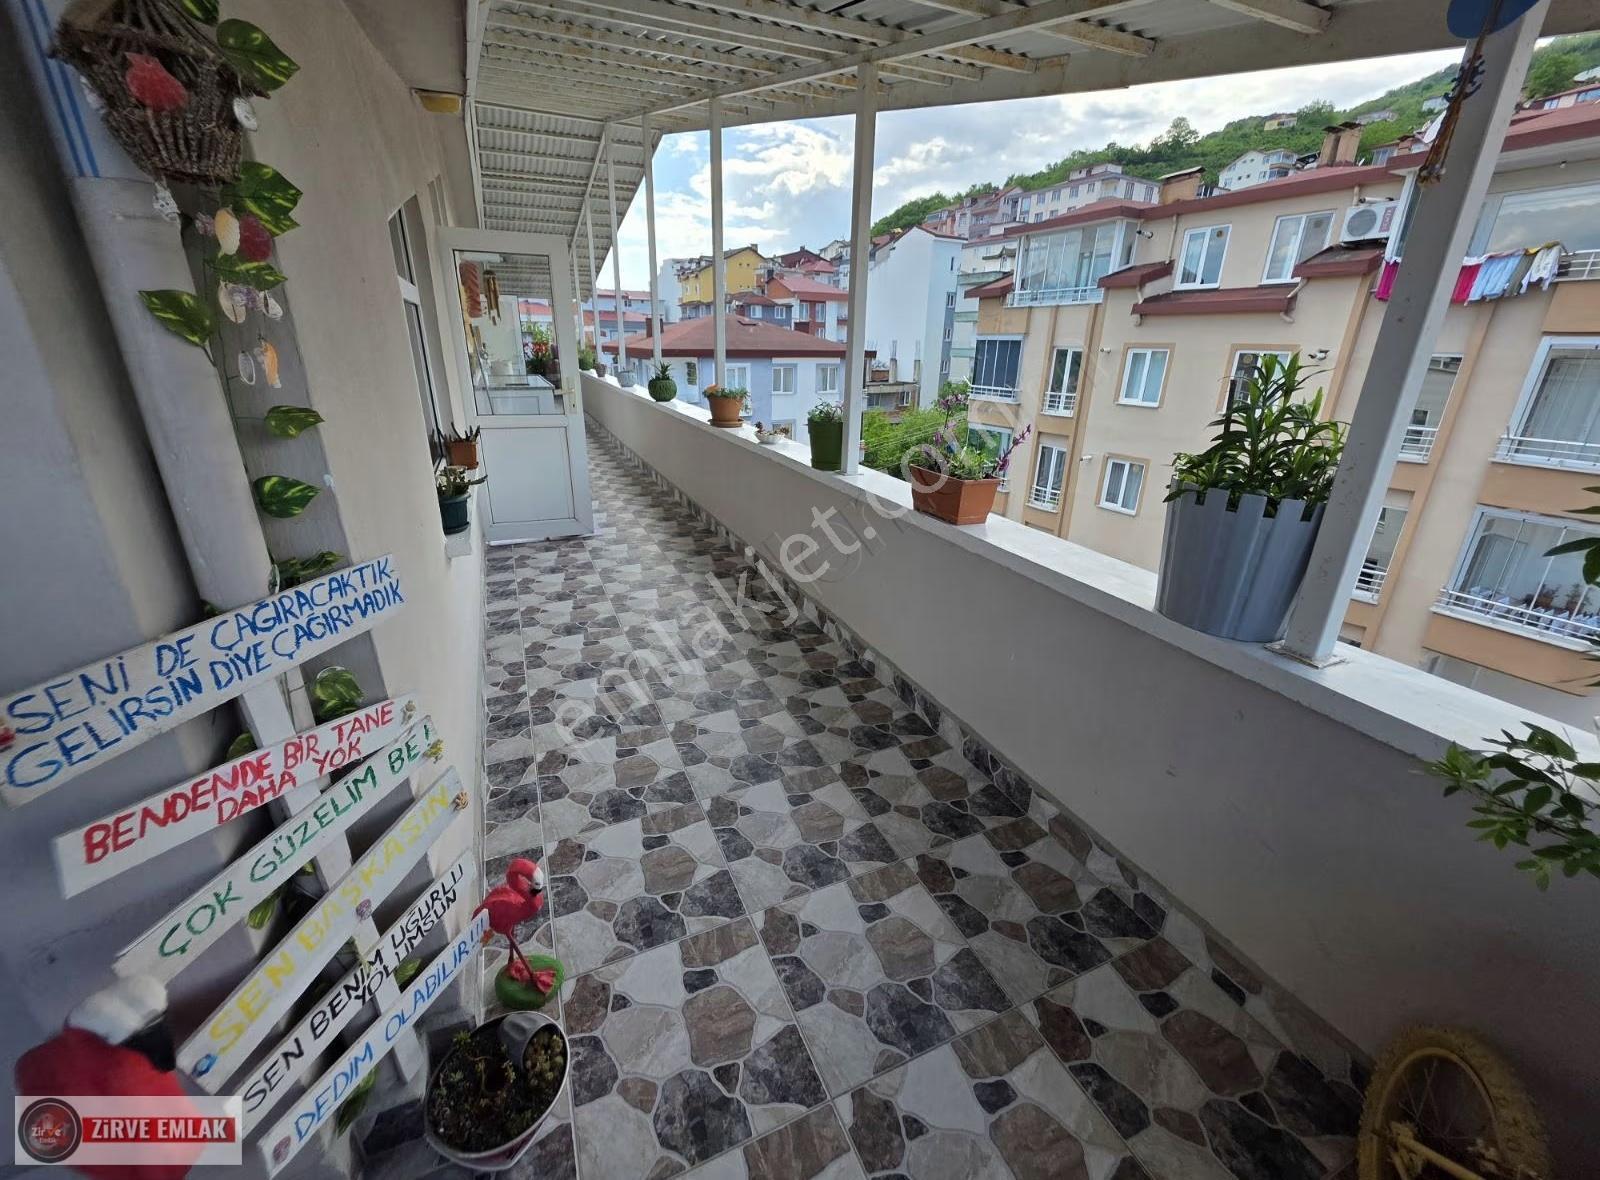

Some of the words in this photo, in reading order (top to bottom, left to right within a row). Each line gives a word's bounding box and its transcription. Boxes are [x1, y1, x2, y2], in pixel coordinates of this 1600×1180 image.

[7, 655, 129, 734] SENİ
[156, 634, 200, 676] DE
[209, 641, 271, 690] DİYE
[272, 579, 404, 660] ÇAĞIRMADIK
[83, 751, 273, 865] BENDENDE
[284, 734, 319, 769] BİR
[331, 701, 395, 745] TANE
[217, 771, 297, 824] DAHA
[312, 737, 362, 776] YOK
[159, 881, 242, 959] ÇOK
[250, 765, 377, 883] GÜZELİM
[210, 951, 294, 1055] SEN
[243, 1037, 304, 1113] SEN
